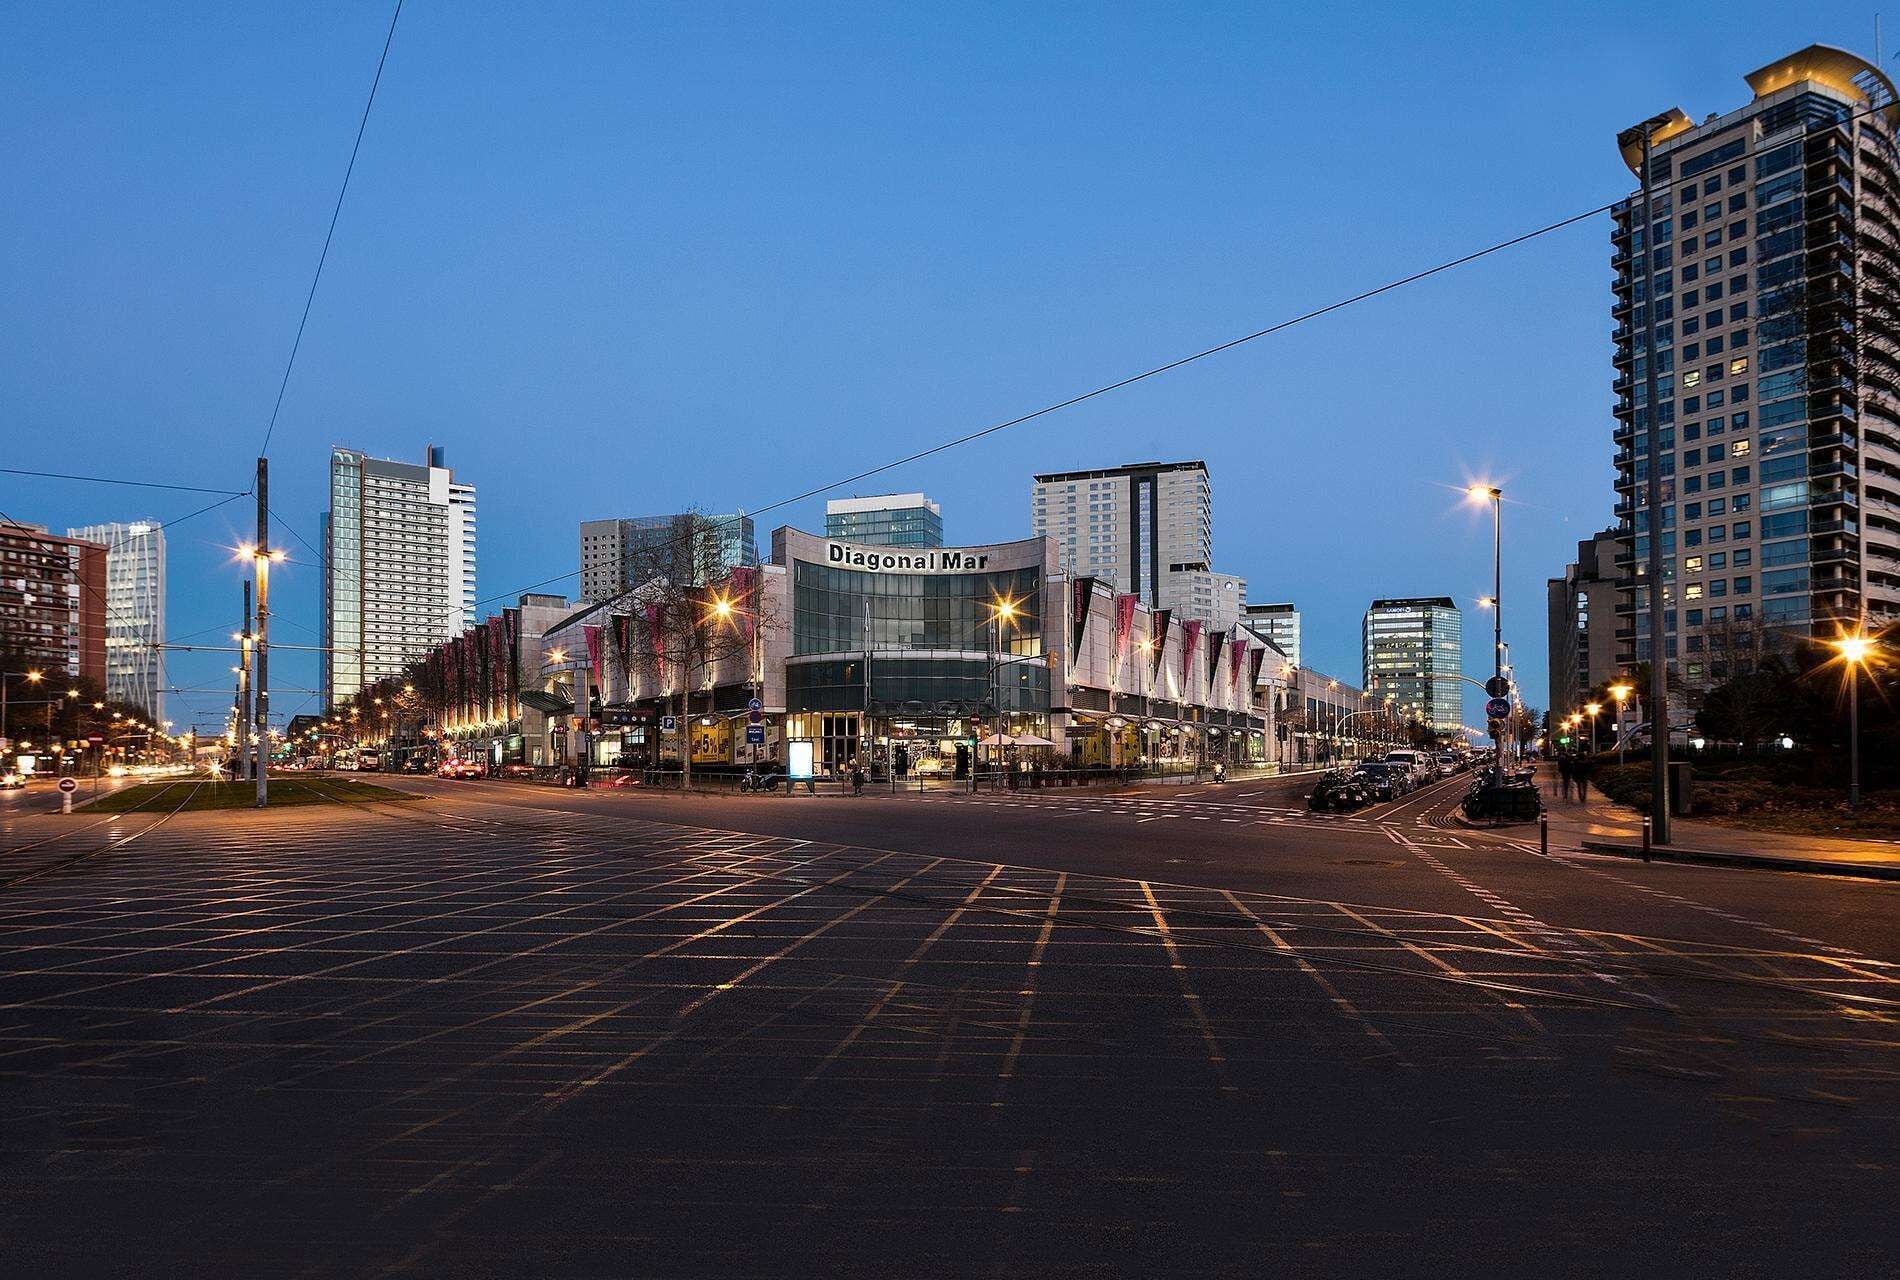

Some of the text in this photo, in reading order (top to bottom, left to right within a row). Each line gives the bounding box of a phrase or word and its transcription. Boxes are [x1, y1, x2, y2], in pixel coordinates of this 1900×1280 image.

[829, 543, 988, 571] Diagonal Mar
[1074, 594, 1082, 623] Diagonal
[667, 719, 673, 728] P
[702, 734, 718, 754] 5%
